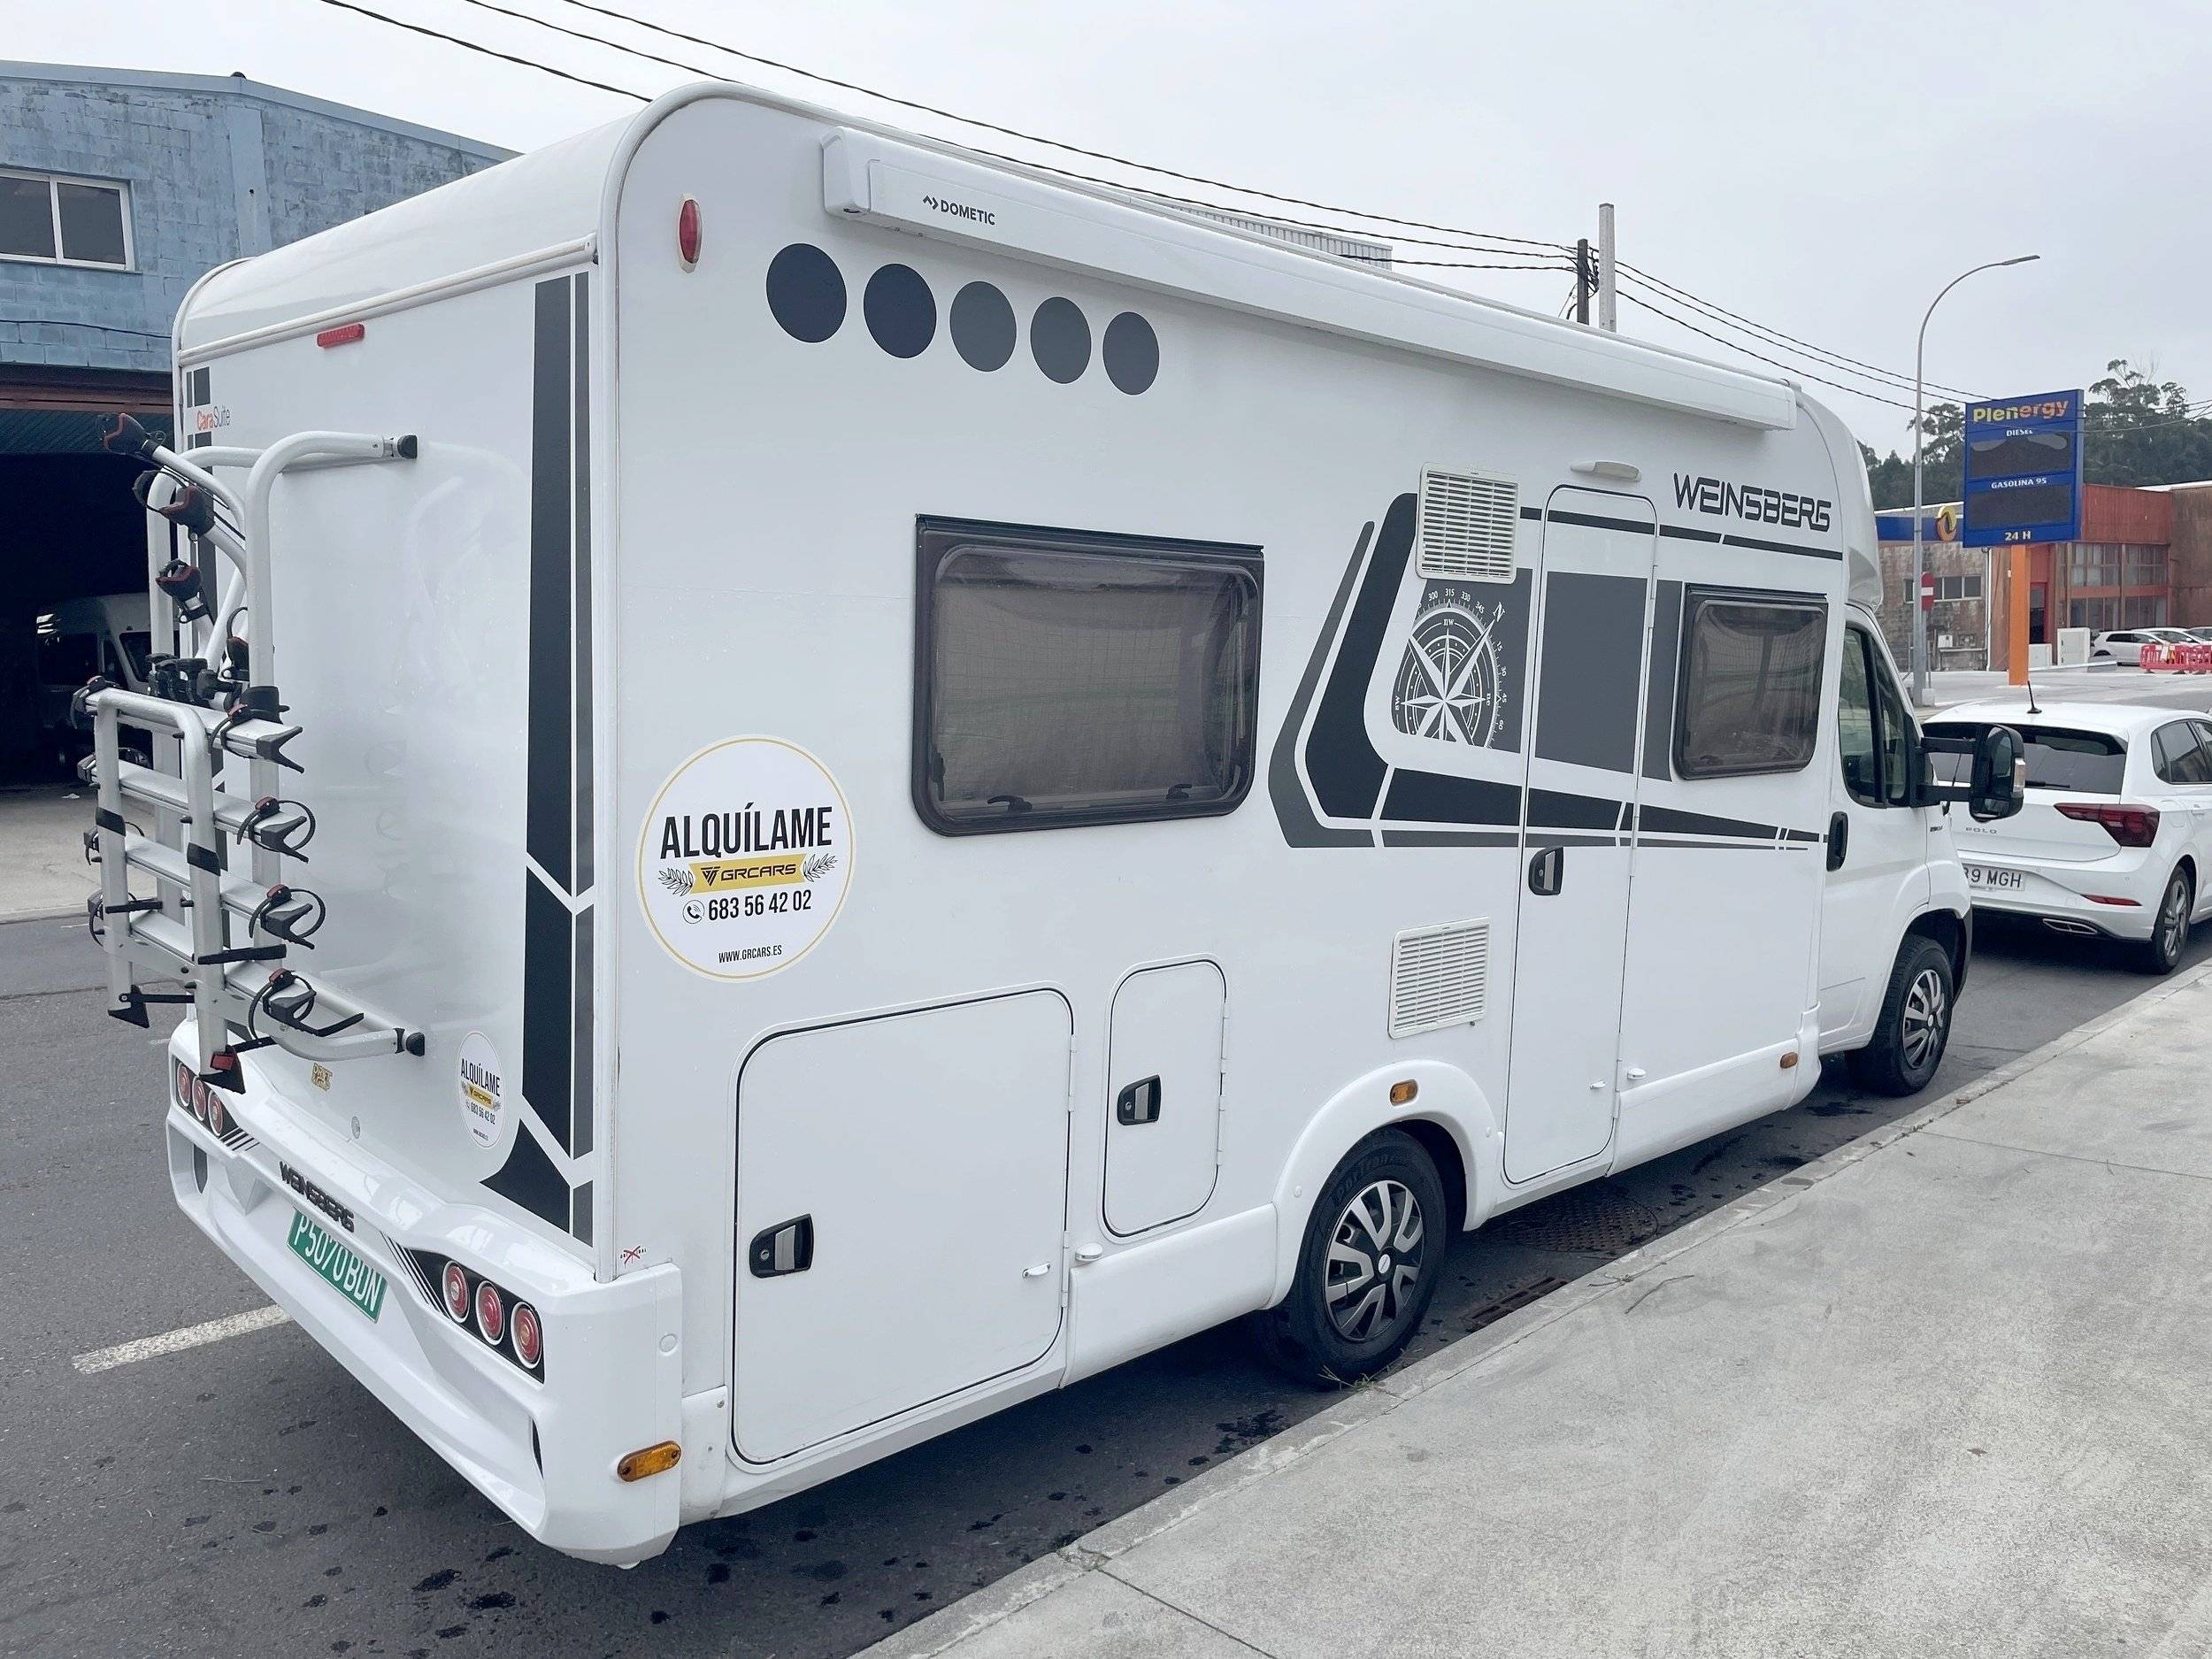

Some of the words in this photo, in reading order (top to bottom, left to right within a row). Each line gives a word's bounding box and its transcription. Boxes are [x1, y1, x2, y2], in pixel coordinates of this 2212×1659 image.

[941, 199, 995, 226] DOMETIC
[197, 405, 230, 431] CaraSuite
[1972, 400, 2069, 423] Plenergy
[1991, 479, 2034, 489] GASOLINA
[1674, 472, 1832, 533] WEINSBERG
[2004, 531, 2019, 541] 24
[2023, 530, 2032, 540] H
[1428, 591, 1439, 602] 300
[1445, 588, 1455, 597] 315
[1461, 591, 1471, 602] 330
[1475, 602, 1485, 613] 345
[660, 802, 833, 860] ALQUÍLAME
[720, 864, 796, 881] GRCARS
[1986, 870, 2022, 888] MGH
[708, 896, 740, 921] 683
[744, 894, 764, 917] 56
[769, 891, 788, 914] 42
[792, 889, 812, 911] 02
[718, 944, 783, 964] WWW.GRCARS.ES
[460, 1058, 501, 1097] ALQUÍLAME
[279, 1161, 355, 1233] WEINSBERG
[295, 1215, 383, 1312] P5070BDN
